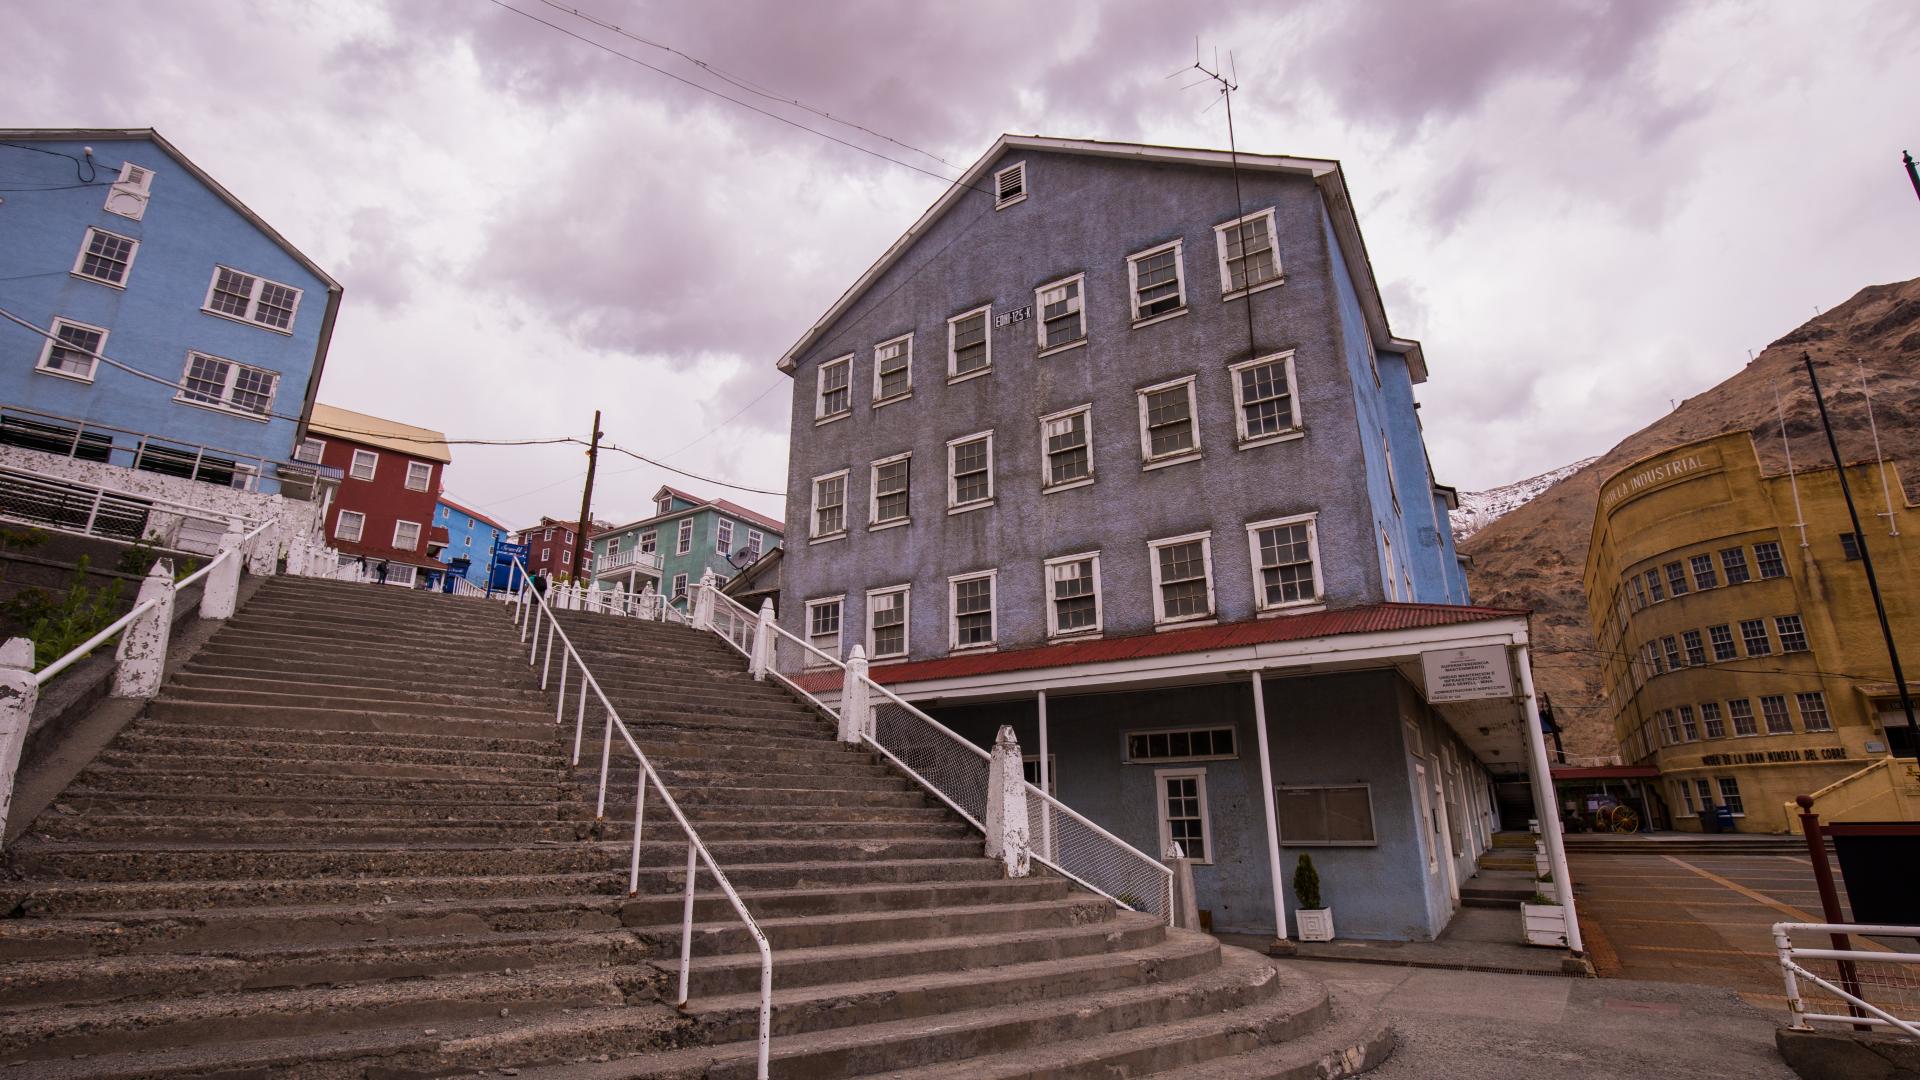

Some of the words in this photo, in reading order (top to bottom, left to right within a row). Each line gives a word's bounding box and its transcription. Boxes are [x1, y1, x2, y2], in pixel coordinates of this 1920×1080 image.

[1631, 455, 1708, 491] INDUSTRIAL
[1767, 750, 1800, 762] MINERIA
[1804, 749, 1818, 760] DEL
[1821, 748, 1847, 760] COBRE
